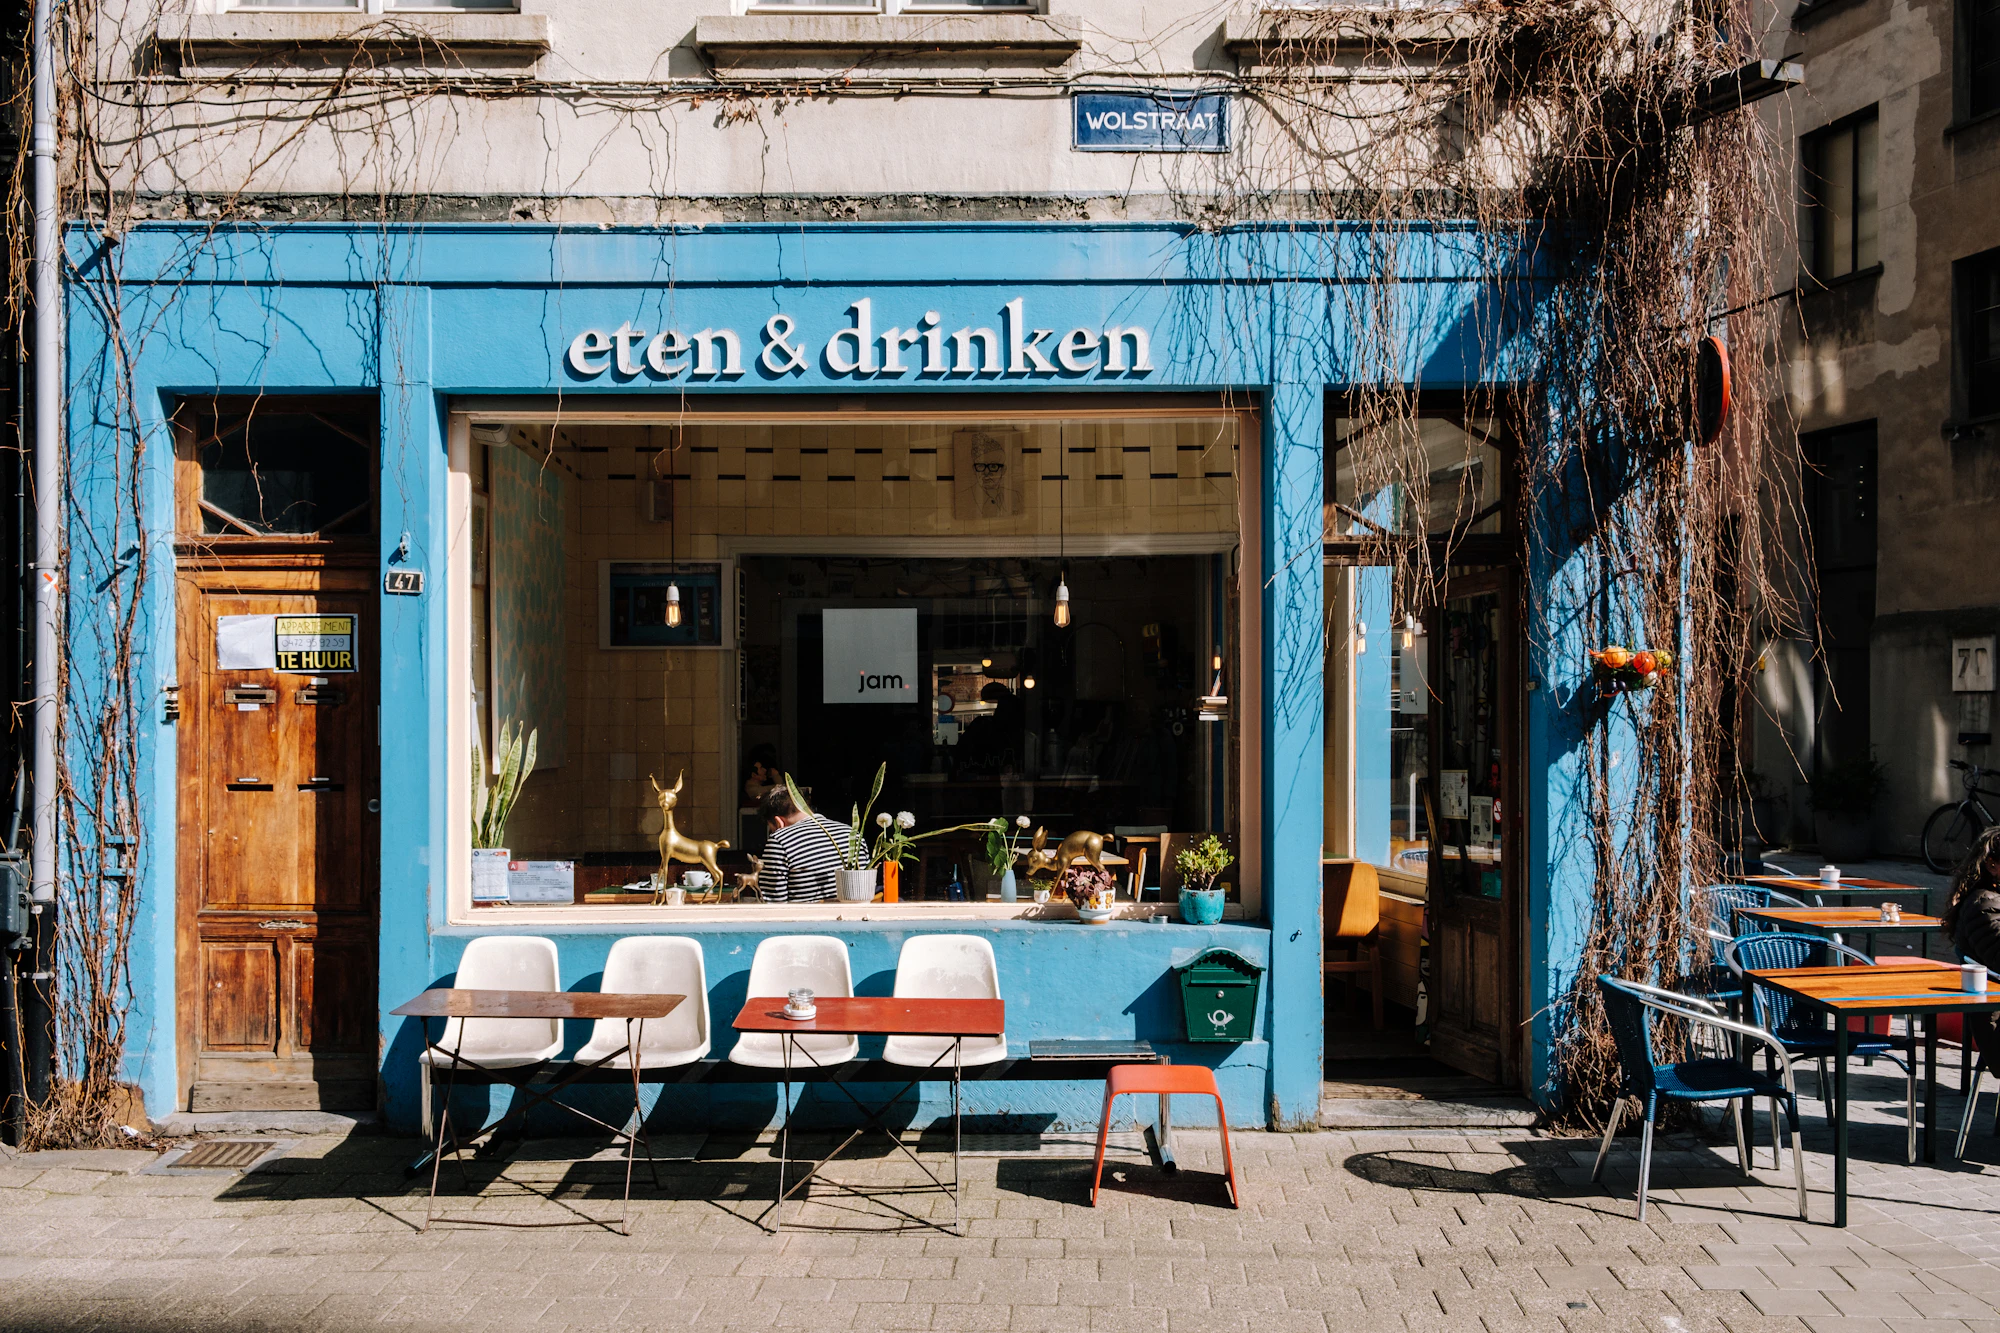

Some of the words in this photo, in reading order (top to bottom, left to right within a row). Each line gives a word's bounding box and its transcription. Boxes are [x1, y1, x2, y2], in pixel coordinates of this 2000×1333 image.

[1086, 112, 1218, 130] WOLSTRAAT
[568, 320, 746, 375] eten
[762, 314, 809, 374] &
[826, 297, 1154, 374] drinken
[394, 574, 415, 589] 47
[280, 620, 351, 631] APPARTEMENT
[277, 651, 299, 669] TE
[302, 651, 351, 669] HUUR
[858, 671, 909, 693] jam.
